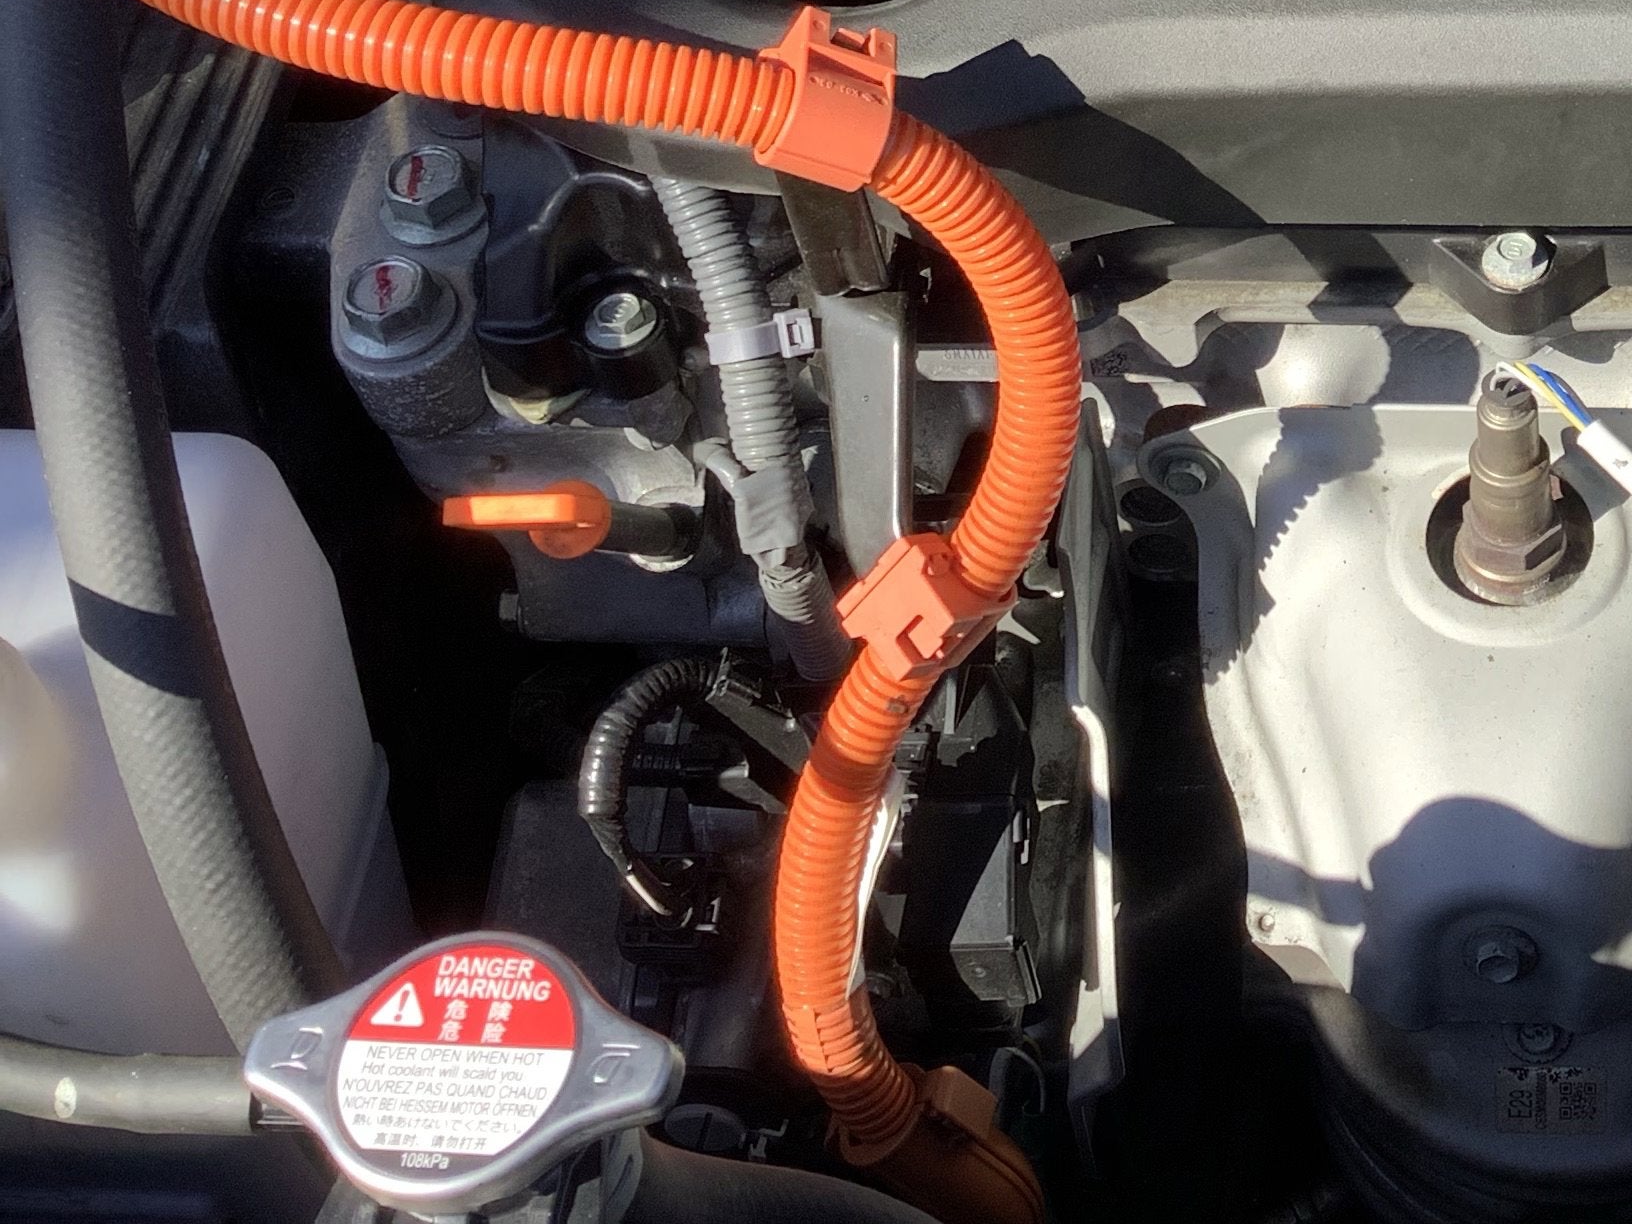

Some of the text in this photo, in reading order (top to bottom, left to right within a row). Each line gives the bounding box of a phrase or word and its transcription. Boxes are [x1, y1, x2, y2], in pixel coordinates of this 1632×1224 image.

[438, 955, 535, 980] DANGER
[434, 977, 552, 1002] WARNUNG
[366, 1045, 545, 1066] NEVER OPEN WHEN HOT
[361, 1061, 524, 1084] Hot coolant will scald you
[342, 1077, 548, 1101] N'OUVREZ PAS QUAND CHAUD
[342, 1096, 379, 1110] NICHT
[377, 1097, 398, 1111] BEI
[399, 1098, 449, 1114] HEISSEM
[450, 1101, 491, 1116] MOTOR
[1507, 1089, 1533, 1118] E29
[401, 1152, 450, 1170] 108kPa
